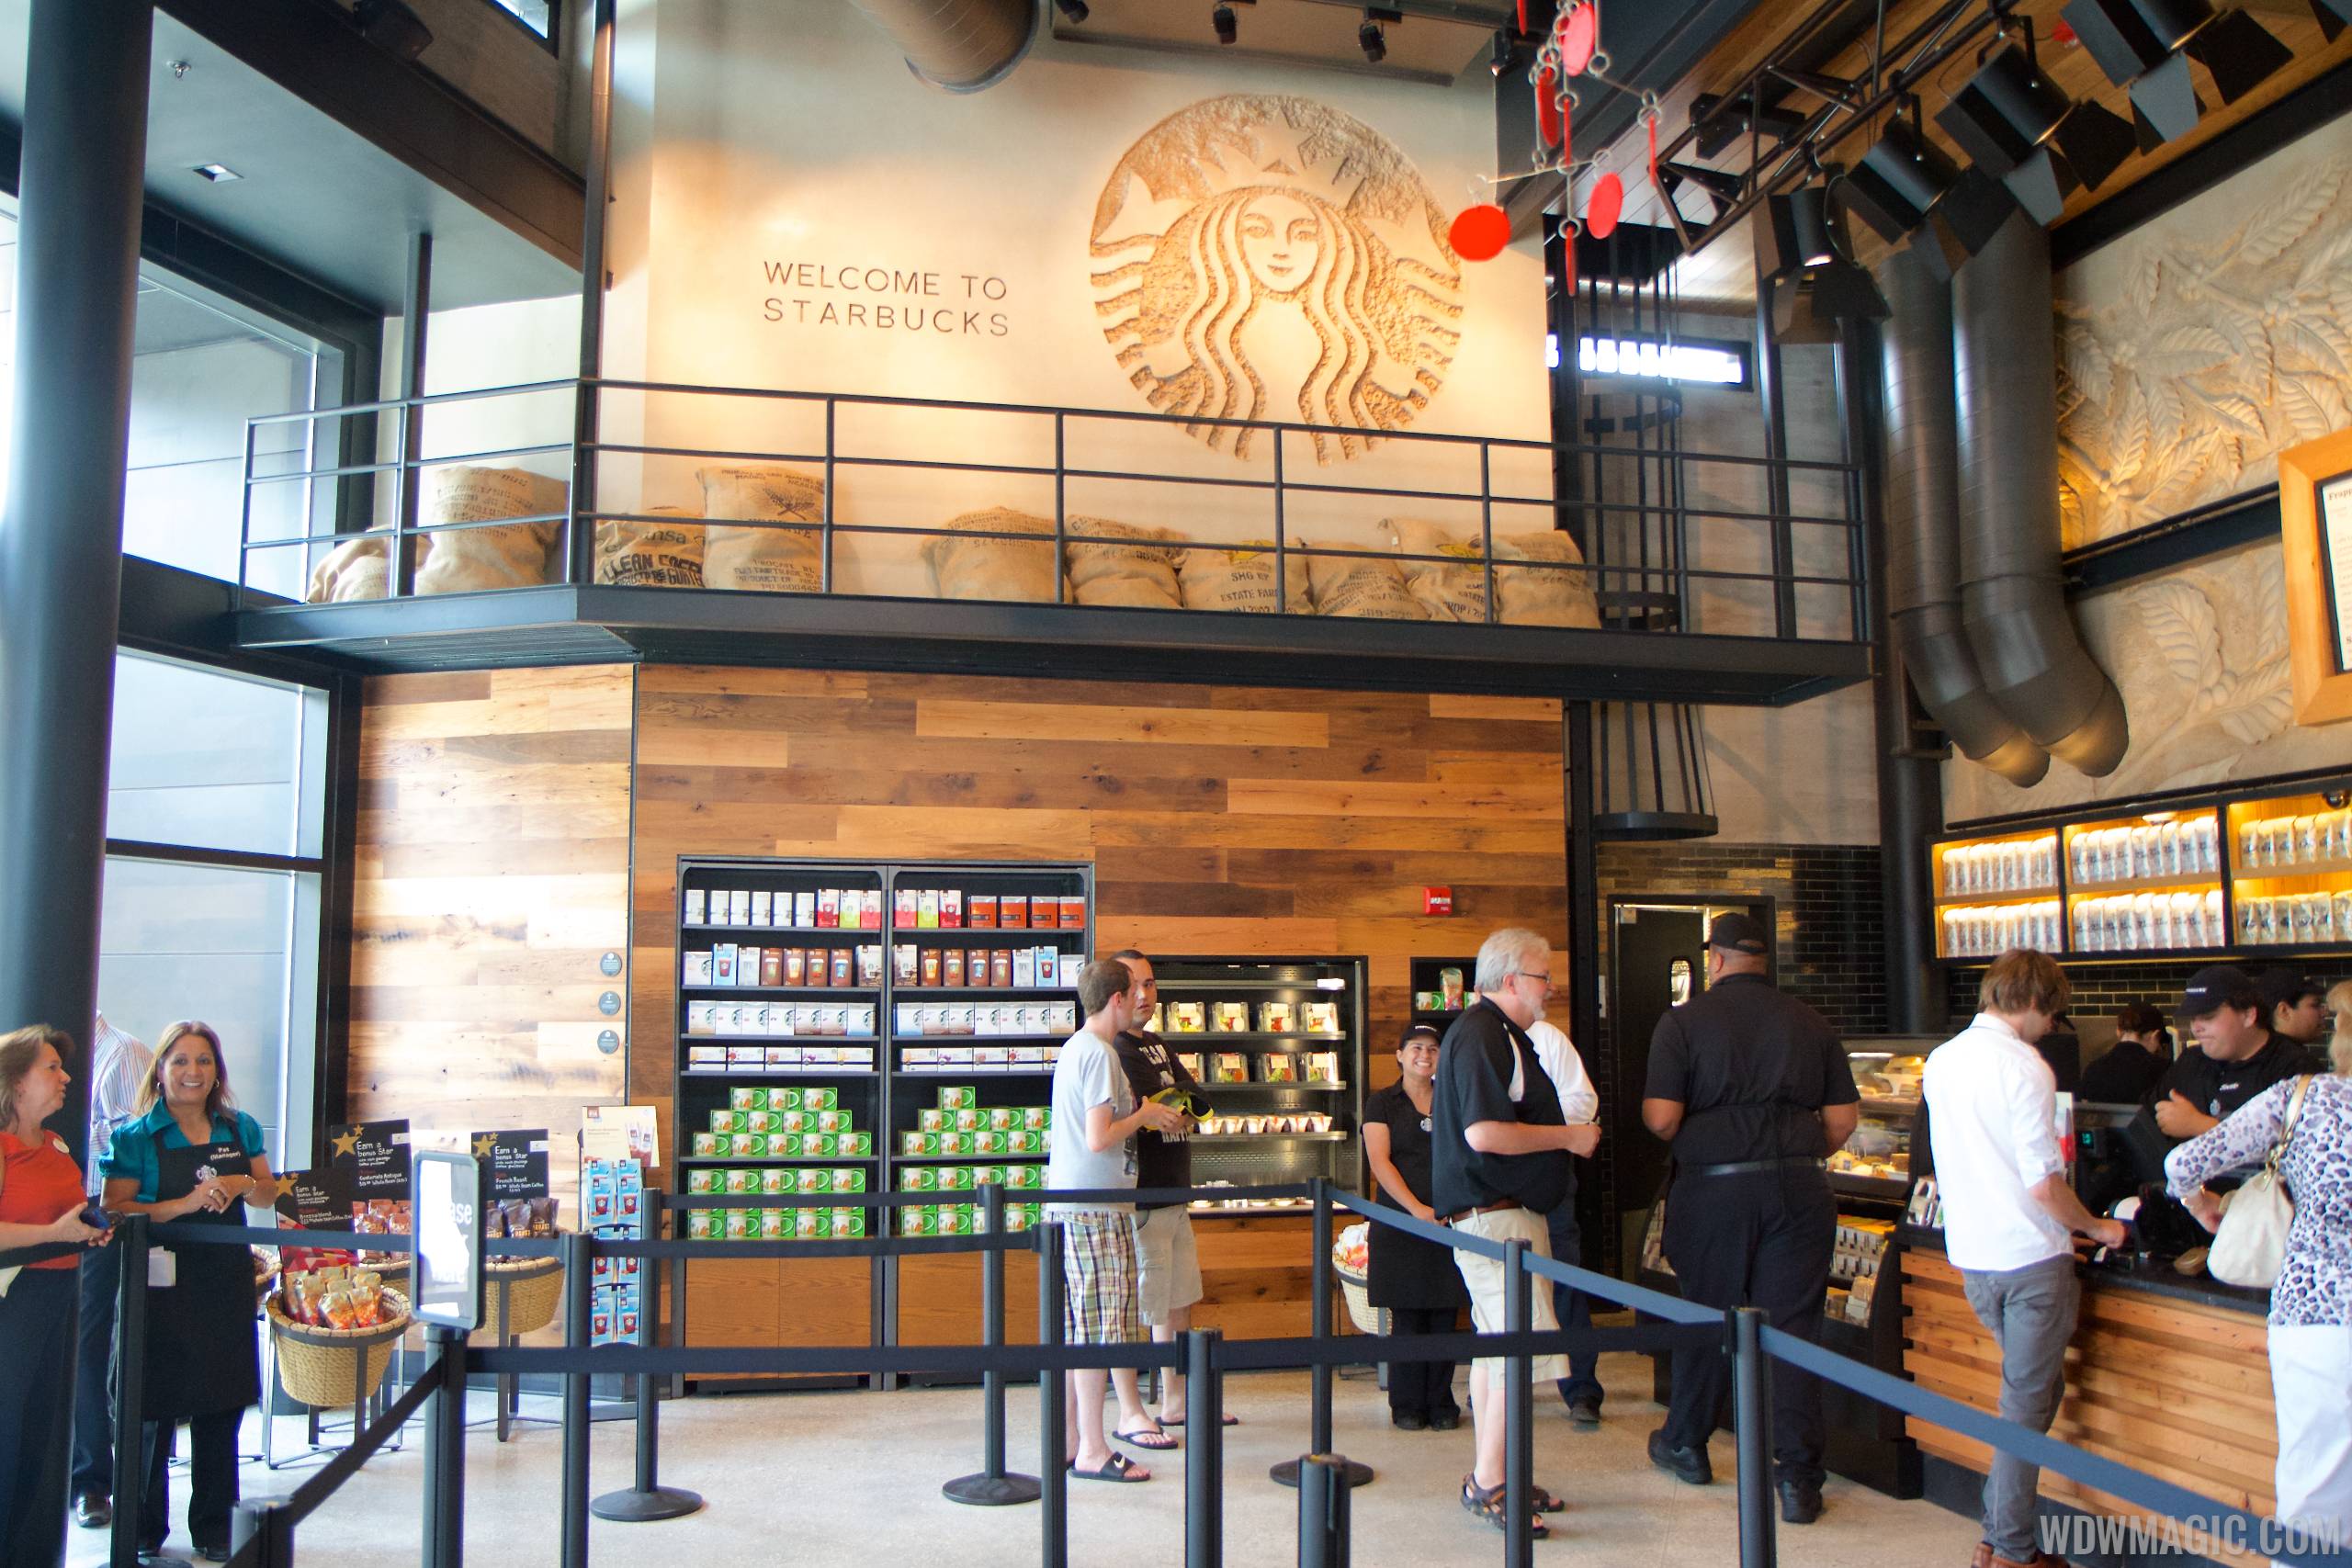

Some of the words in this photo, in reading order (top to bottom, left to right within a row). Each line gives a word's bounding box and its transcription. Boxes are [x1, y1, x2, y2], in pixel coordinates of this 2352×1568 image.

[763, 261, 940, 296] WELCOME
[961, 275, 1007, 300] TO
[763, 298, 1008, 337] STARBUCKS
[1220, 589, 1256, 603] ESTATE
[356, 1141, 374, 1150] Earn
[378, 1147, 394, 1156] Star
[495, 1145, 510, 1155] Earn
